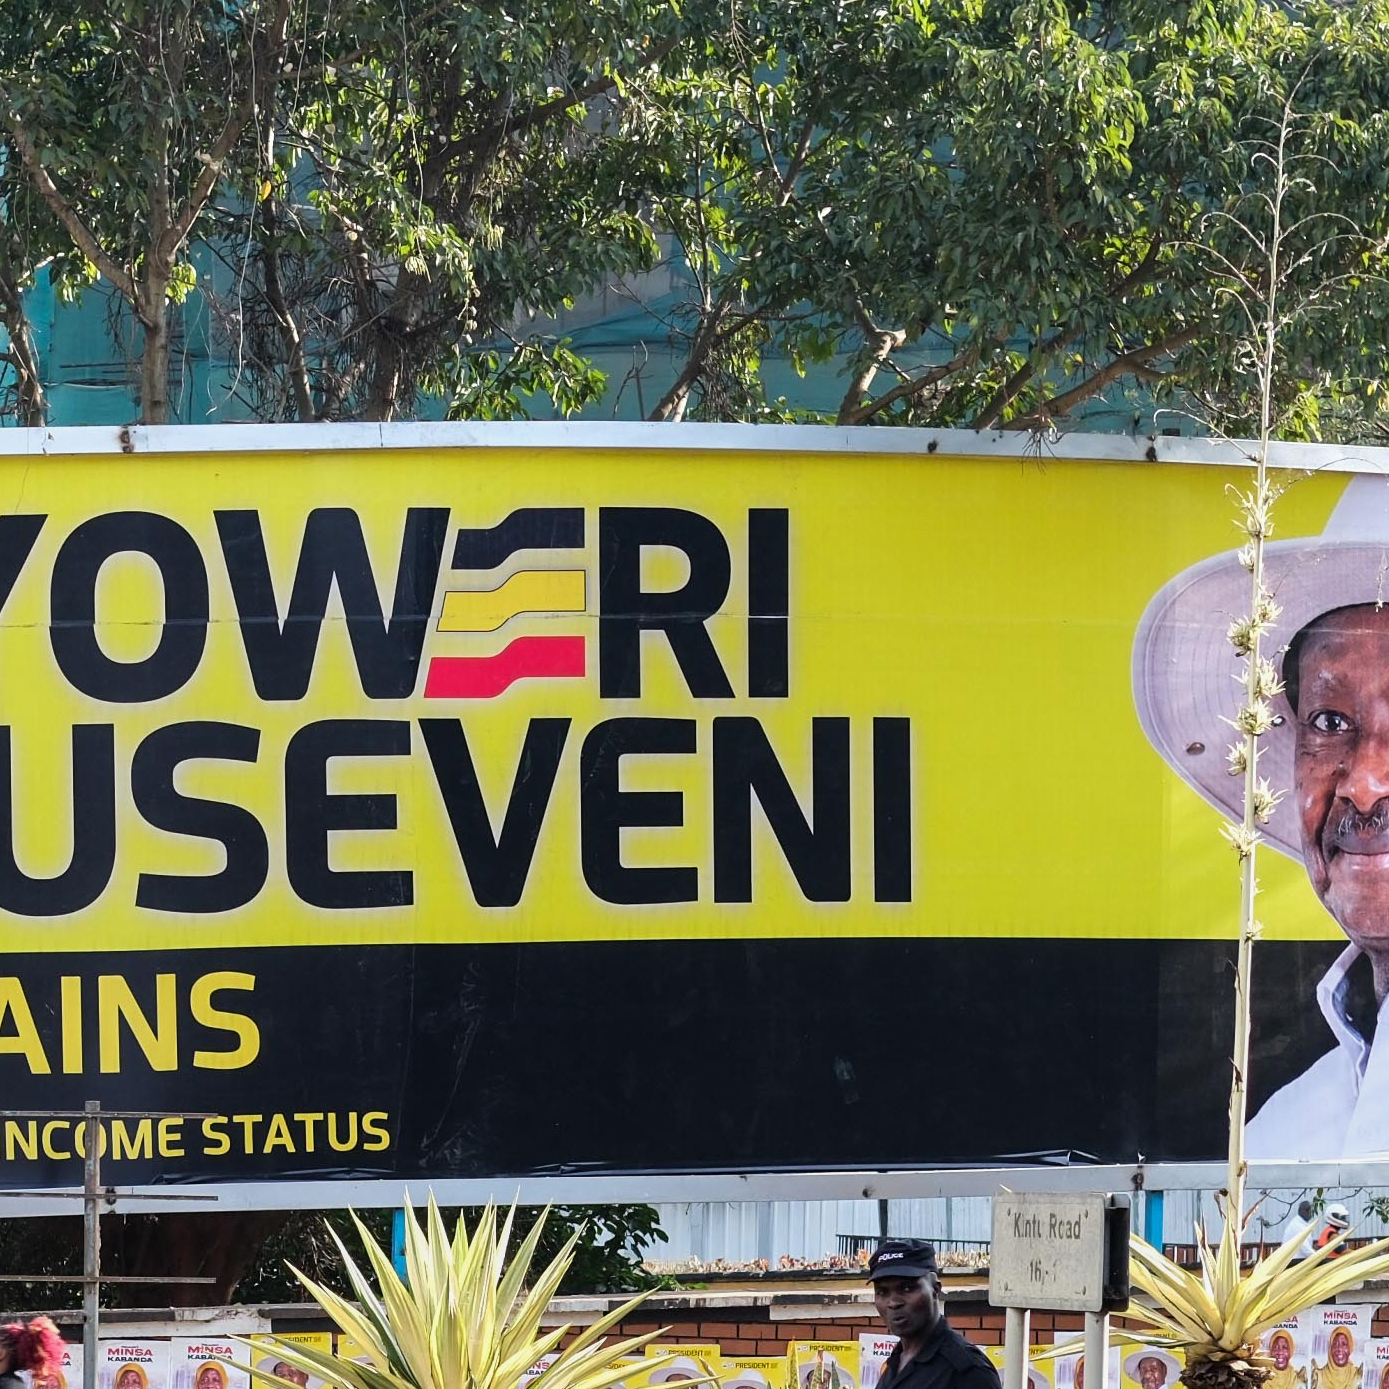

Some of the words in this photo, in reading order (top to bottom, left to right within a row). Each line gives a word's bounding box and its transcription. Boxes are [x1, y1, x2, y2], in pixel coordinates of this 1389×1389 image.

[202, 1111, 390, 1152] STATUS
[878, 1253, 904, 1262] POLICE
[1324, 1312, 1357, 1320] MINSA
[187, 1345, 233, 1354] MINSA
[874, 1342, 897, 1350] MIN
[107, 1348, 152, 1356] MINSA
